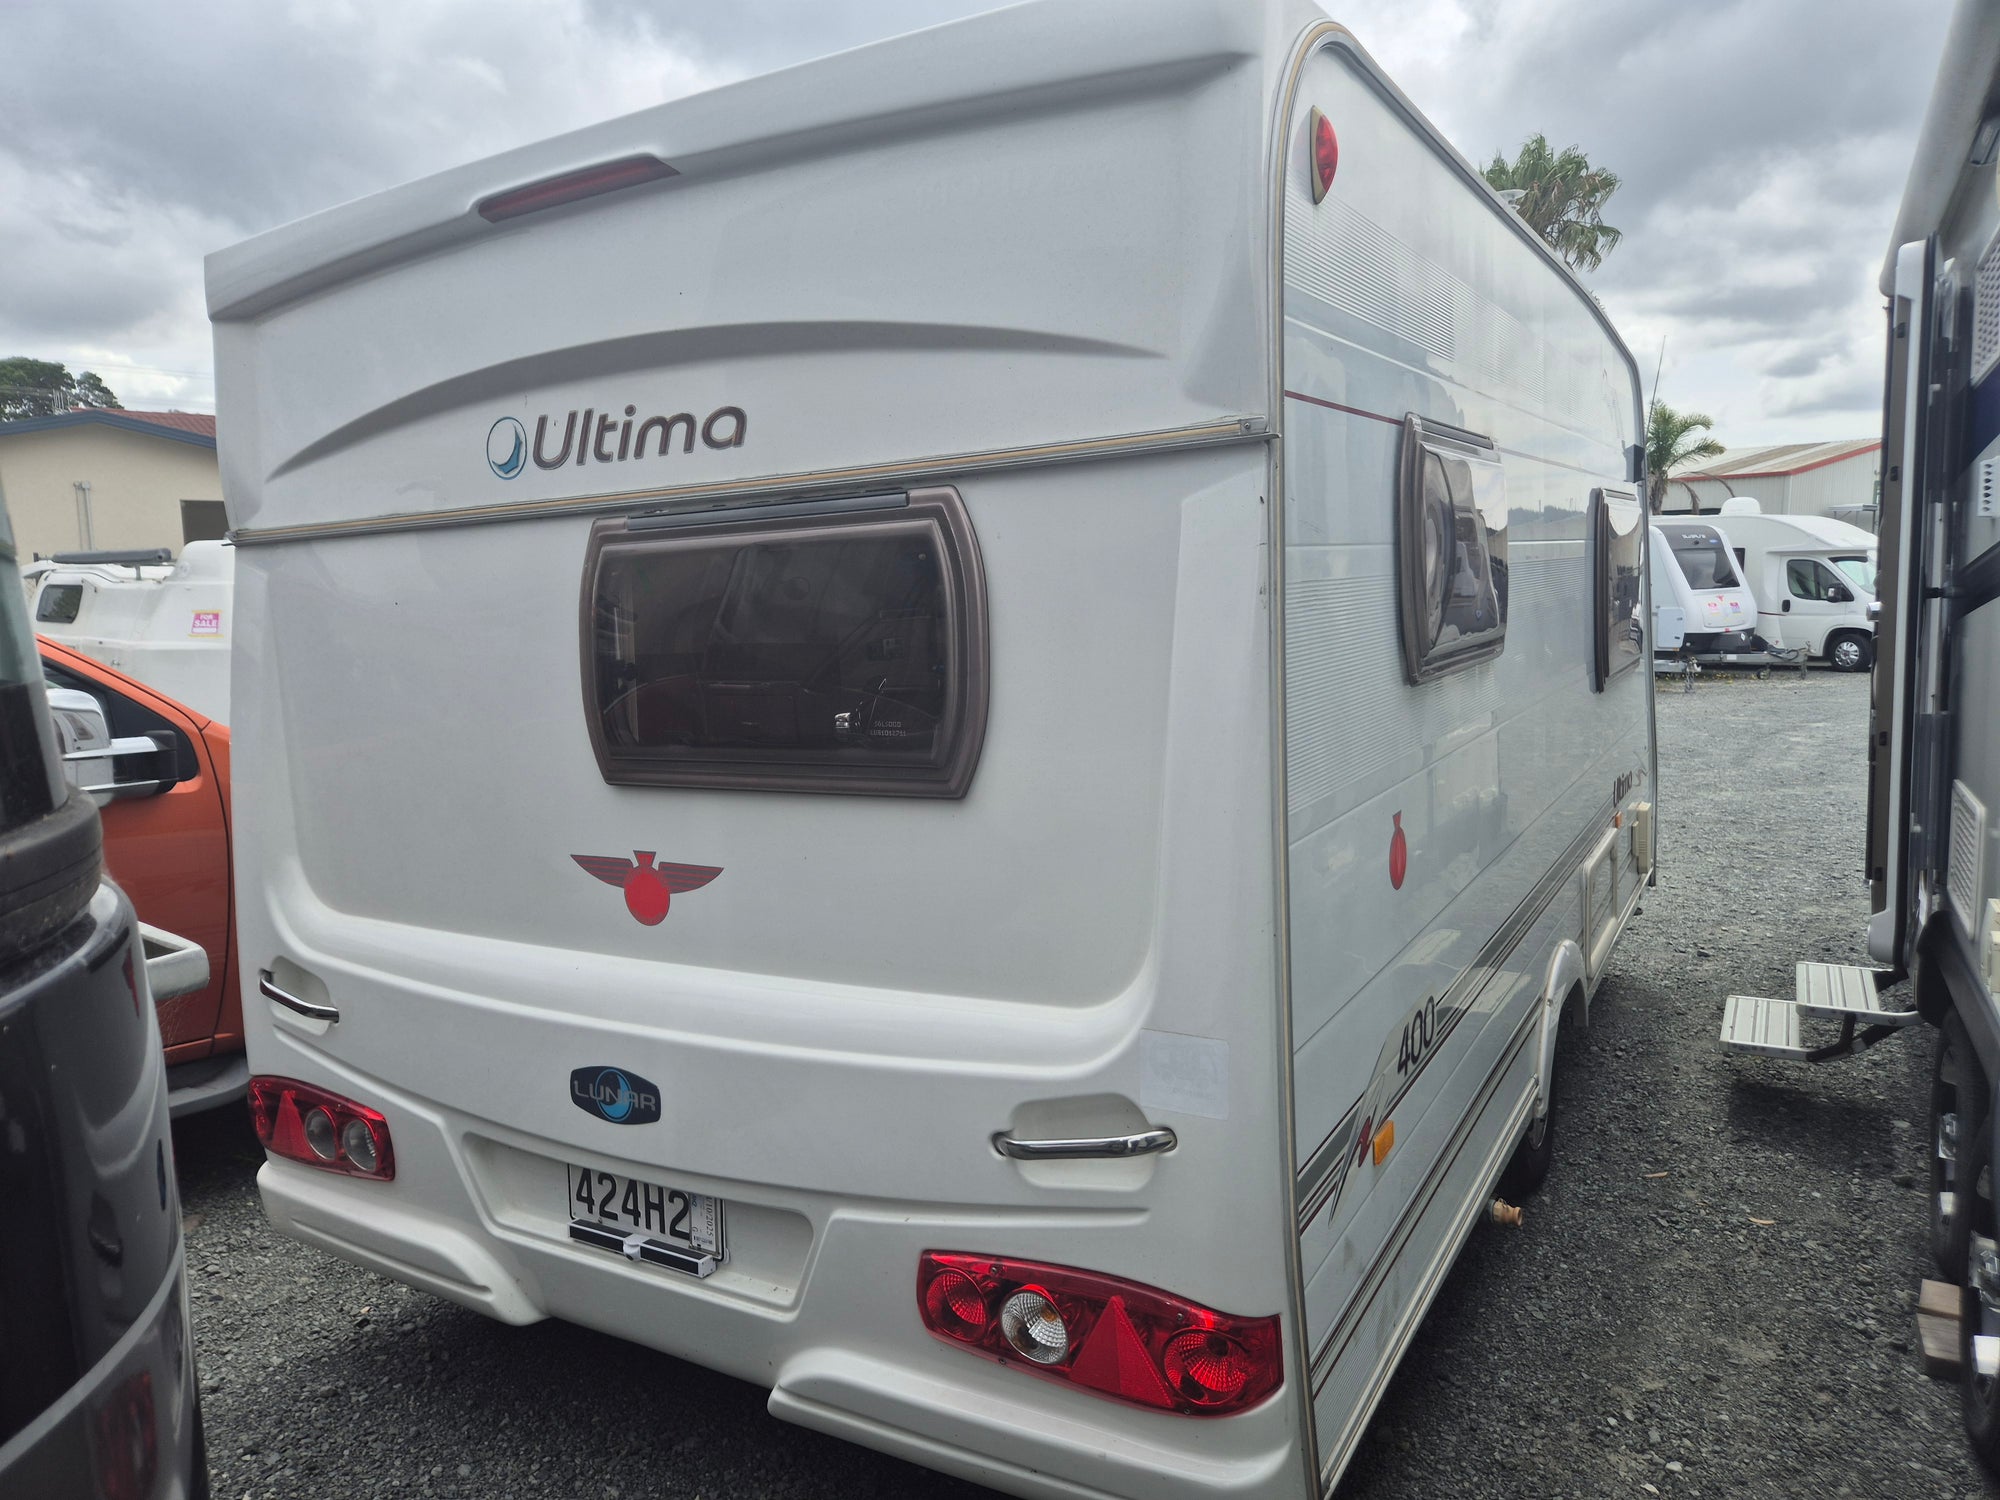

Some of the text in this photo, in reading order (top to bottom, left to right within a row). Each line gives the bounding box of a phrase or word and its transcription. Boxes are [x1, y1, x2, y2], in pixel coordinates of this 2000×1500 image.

[532, 404, 748, 470] Ultima
[193, 619, 217, 627] SALE
[1397, 995, 1435, 1077] 400
[574, 1080, 656, 1111] LUNAR
[576, 1168, 690, 1241] 424H2
